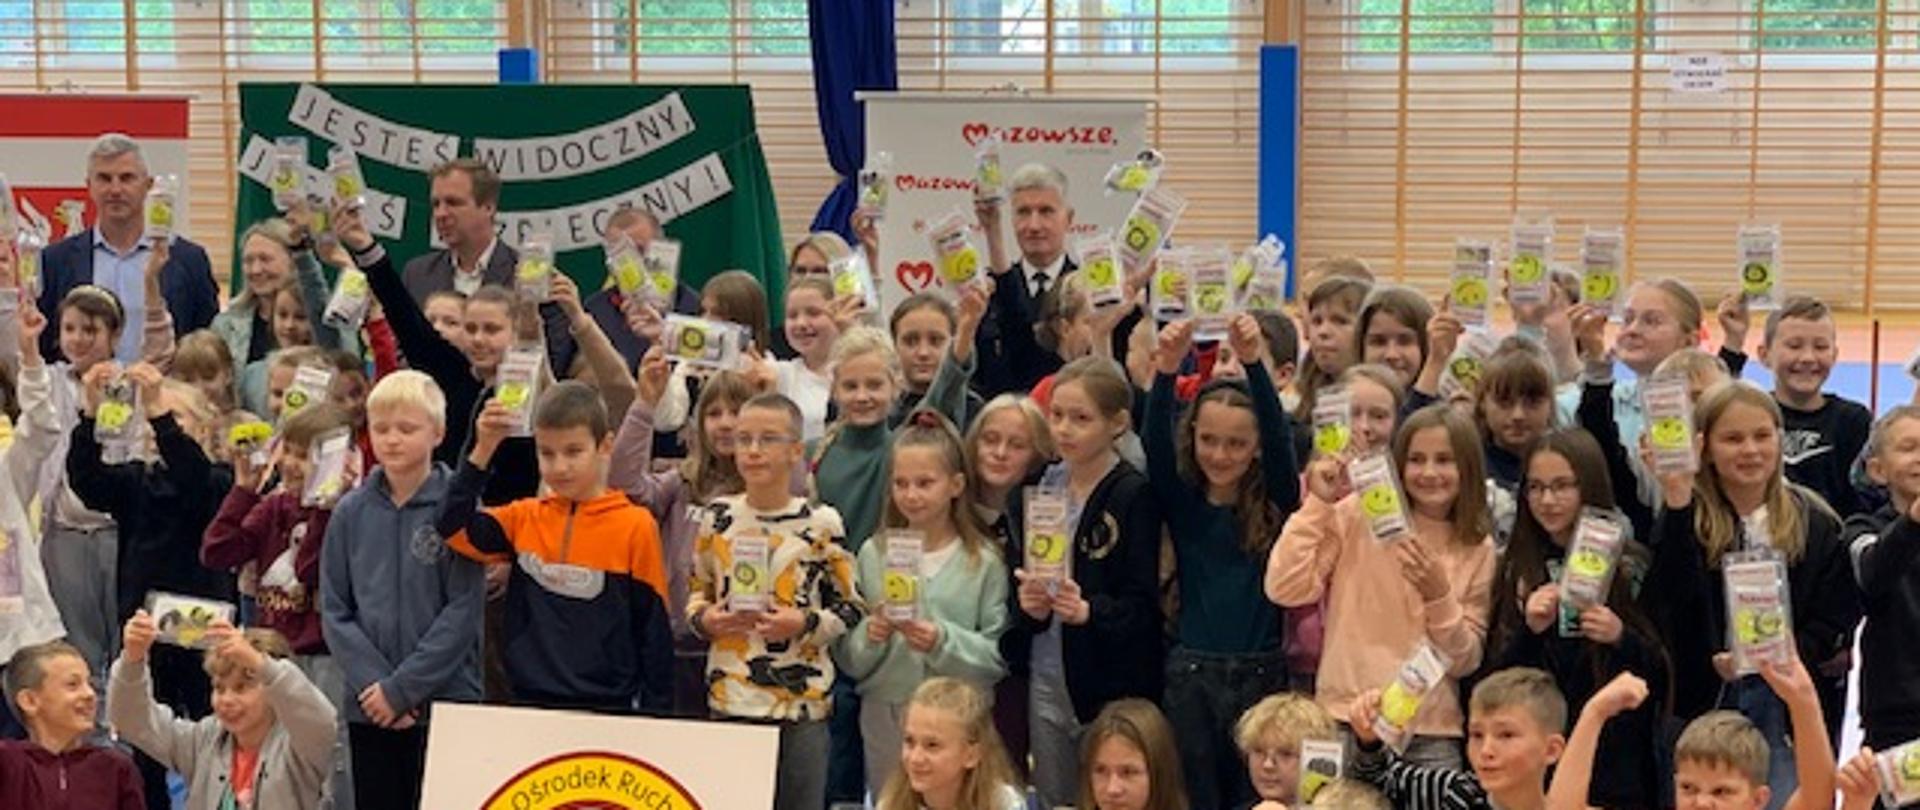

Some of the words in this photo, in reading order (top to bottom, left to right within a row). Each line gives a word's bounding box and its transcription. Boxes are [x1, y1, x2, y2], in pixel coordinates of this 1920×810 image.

[300, 98, 450, 165] JESTEŚ
[476, 106, 692, 174] WIDOCZNY,
[896, 175, 977, 191] Mazow
[511, 765, 611, 810] Ośrodek
[616, 770, 673, 810] Ruch
